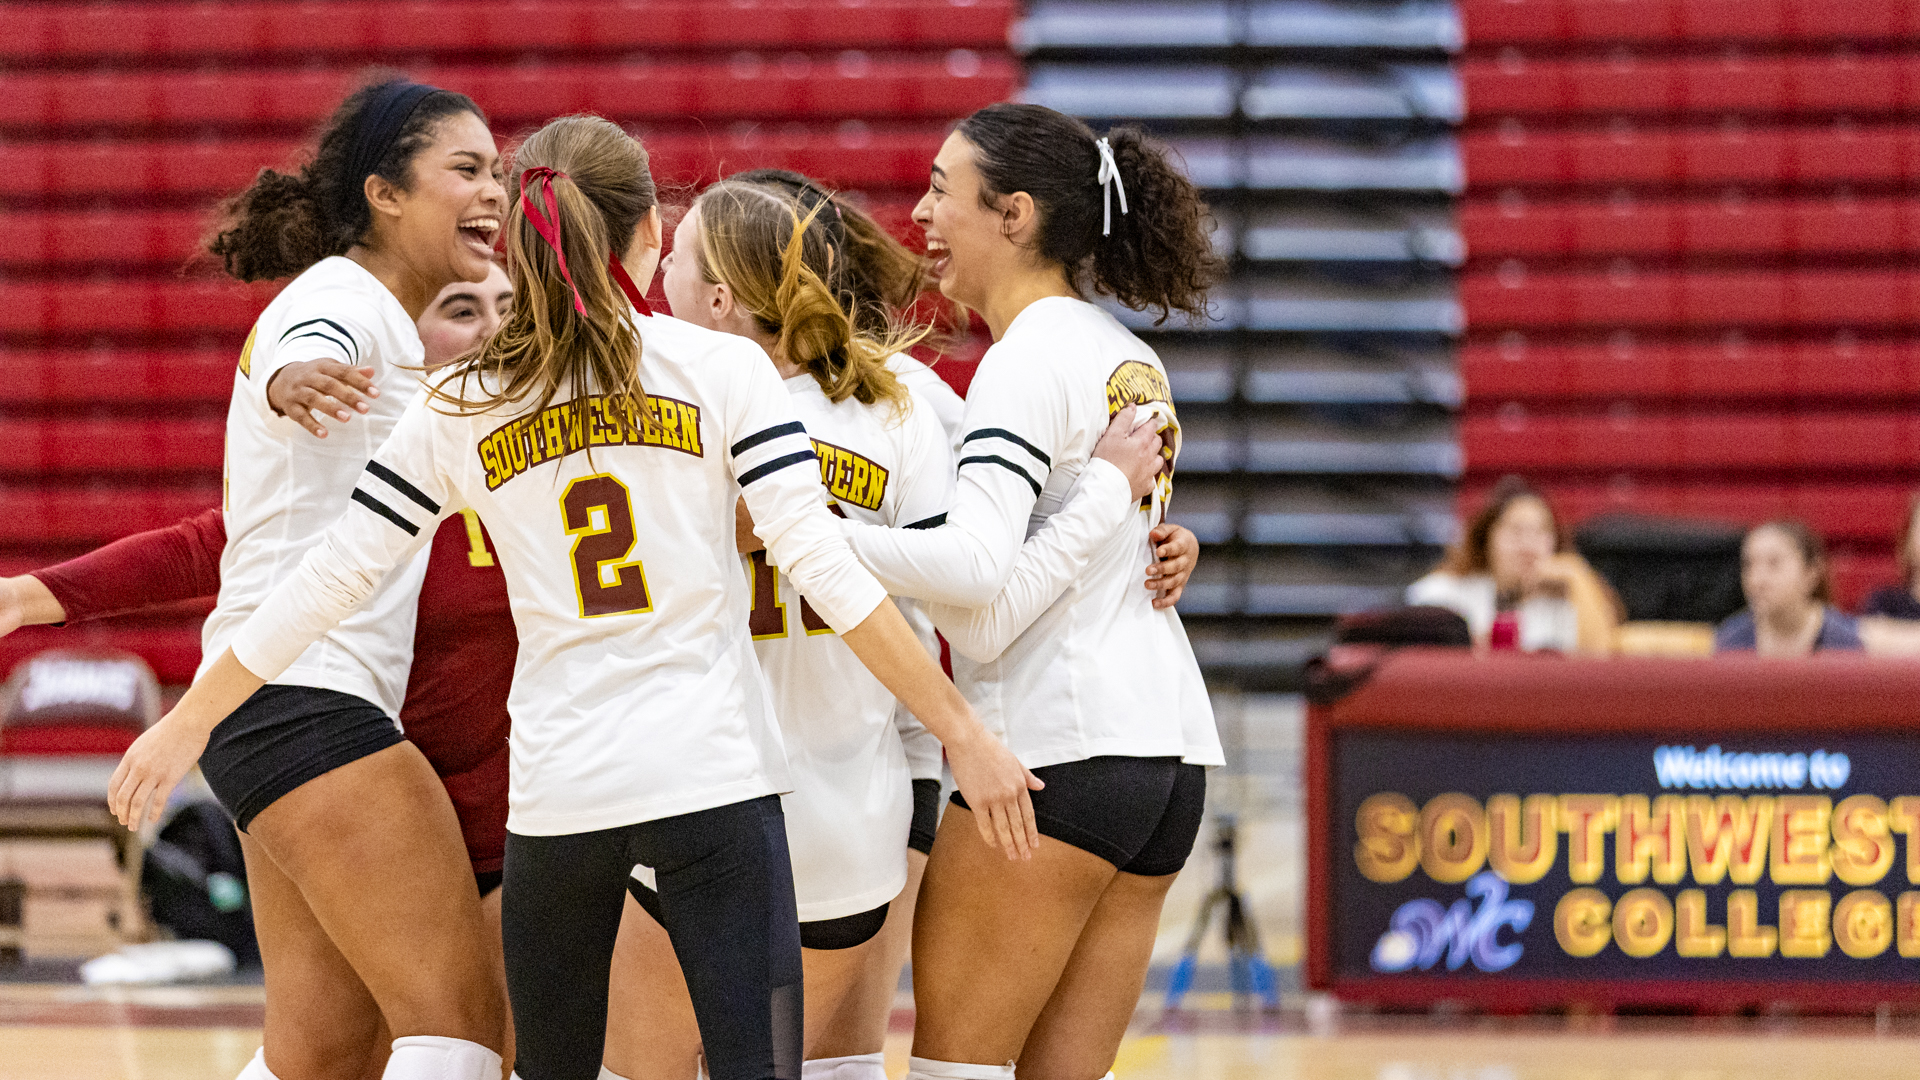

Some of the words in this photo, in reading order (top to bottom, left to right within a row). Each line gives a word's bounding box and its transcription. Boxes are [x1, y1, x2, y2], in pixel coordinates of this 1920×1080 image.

[478, 394, 703, 492] SOUTHWESTERN
[559, 472, 653, 618] 2
[1653, 745, 1806, 788] Welcome
[1809, 749, 1850, 788] to
